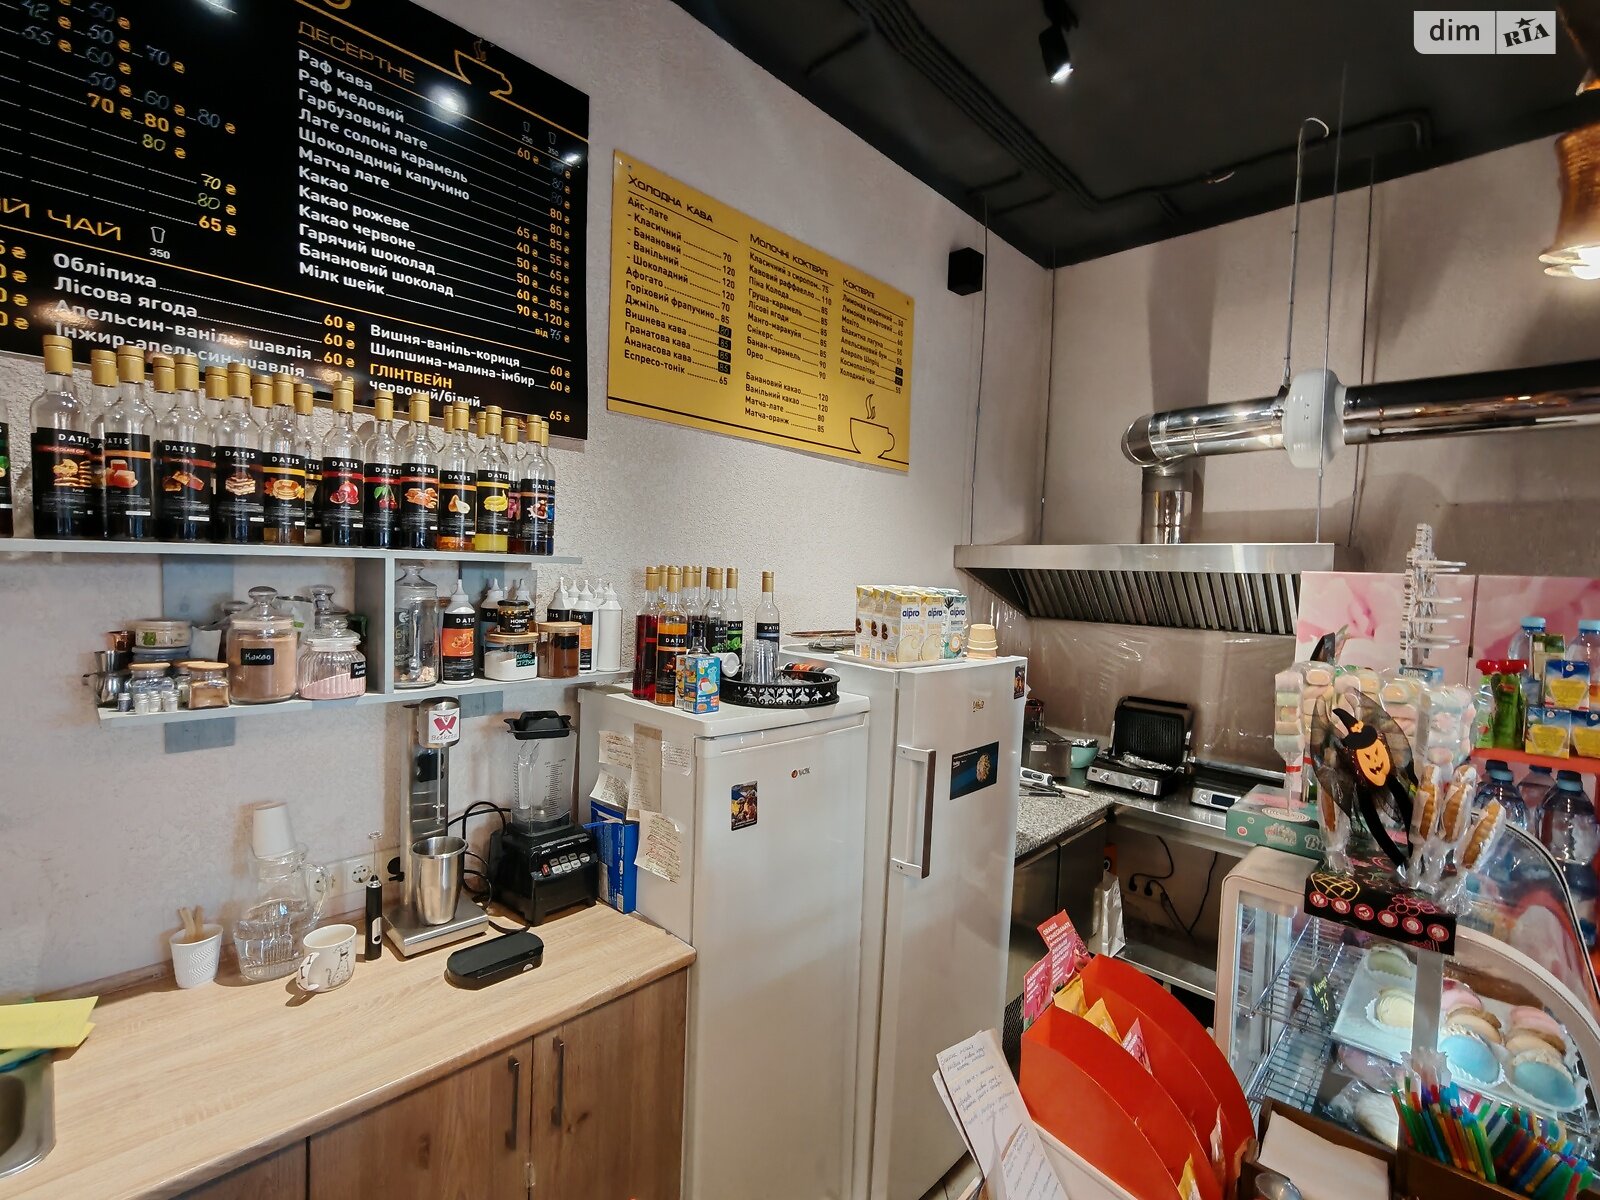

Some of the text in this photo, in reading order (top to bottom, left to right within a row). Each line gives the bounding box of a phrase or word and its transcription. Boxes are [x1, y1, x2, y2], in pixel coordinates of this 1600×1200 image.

[298, 21, 415, 85] ДЕСЕРТНЕ
[87, 93, 170, 132] 70 80
[299, 69, 405, 124] Раф медовий
[299, 49, 531, 161] Раф кава 60
[299, 88, 429, 151] Гарбузовий лате
[142, 134, 166, 152] 80
[299, 107, 563, 221] Лате солона карамель 80
[201, 173, 221, 190] 70
[299, 126, 563, 236] Шоколадний капучино 80
[197, 192, 221, 210] 80
[299, 146, 562, 252] Матча лате 65 85
[627, 196, 669, 222] Айс-лате
[628, 174, 713, 223] ХОЛОДНА КАВА
[47, 209, 122, 241] ЧАЙ
[198, 215, 222, 233] 65
[299, 165, 562, 266] Какао 40 55
[299, 184, 562, 282] Какао рожеве 50 65
[299, 203, 562, 296] Какао червоне 50 65
[634, 212, 732, 263] Класичний 70
[149, 247, 171, 260] 350
[299, 222, 562, 312] Гарячий шоколад 60 85
[633, 226, 736, 277] Банановий 120
[633, 240, 736, 289] Ванільний 120
[749, 252, 786, 275] Класичний
[53, 252, 343, 329] Обліпиха 60
[299, 242, 562, 327] Банановий шоколад 90 120
[626, 266, 730, 312] Афогато 70
[633, 254, 735, 302] Шоколадний 120
[749, 264, 778, 283] Кавовий
[821, 295, 832, 306] 110
[54, 276, 343, 347] Лісова ягода 60
[299, 261, 549, 339] Мілк шейк від
[625, 280, 730, 324] Горіховий фрапучино 85
[625, 294, 660, 313] Джміль
[748, 276, 828, 316] Піна Колода 85
[748, 288, 828, 326] Груша-карамель 85
[748, 300, 769, 315] Лісові
[56, 299, 343, 366] Апельсин-ваніль-шавлія 60
[624, 321, 691, 350] Гранатова кава
[625, 308, 687, 336] Вишнева кава
[747, 312, 827, 348] Манго-маракуйя 85
[370, 324, 563, 378] Вишня-ваніль-кориця 60
[624, 336, 692, 363] Ананасова кава
[746, 336, 827, 369] Банан-карамель 90
[747, 324, 827, 359] Снікерс 85
[369, 342, 563, 394] Шипшина-малина-імбир 60
[369, 363, 453, 389] ГЛІНТВЕЙН
[624, 349, 728, 386] Еспресо-тонік 65
[746, 348, 826, 380] Орео 90
[745, 371, 829, 402] Банановий какао 120
[745, 383, 829, 413] Ванільний какао 120
[549, 411, 563, 422] 65
[744, 407, 825, 433] Матча-оранж 85
[745, 395, 825, 423] Матча-лате 80
[58, 433, 90, 444] DATIS
[165, 444, 196, 454] DATIS
[225, 450, 256, 459] DATIS
[271, 456, 300, 465] DATIS
[332, 460, 358, 469] DATIS
[375, 467, 399, 475] DATIS
[410, 466, 435, 474] DATIS
[448, 473, 471, 481] DATIS
[487, 472, 508, 480] DATIS
[902, 607, 920, 619] alpro
[927, 607, 943, 619] alpro
[949, 606, 966, 618] alpro
